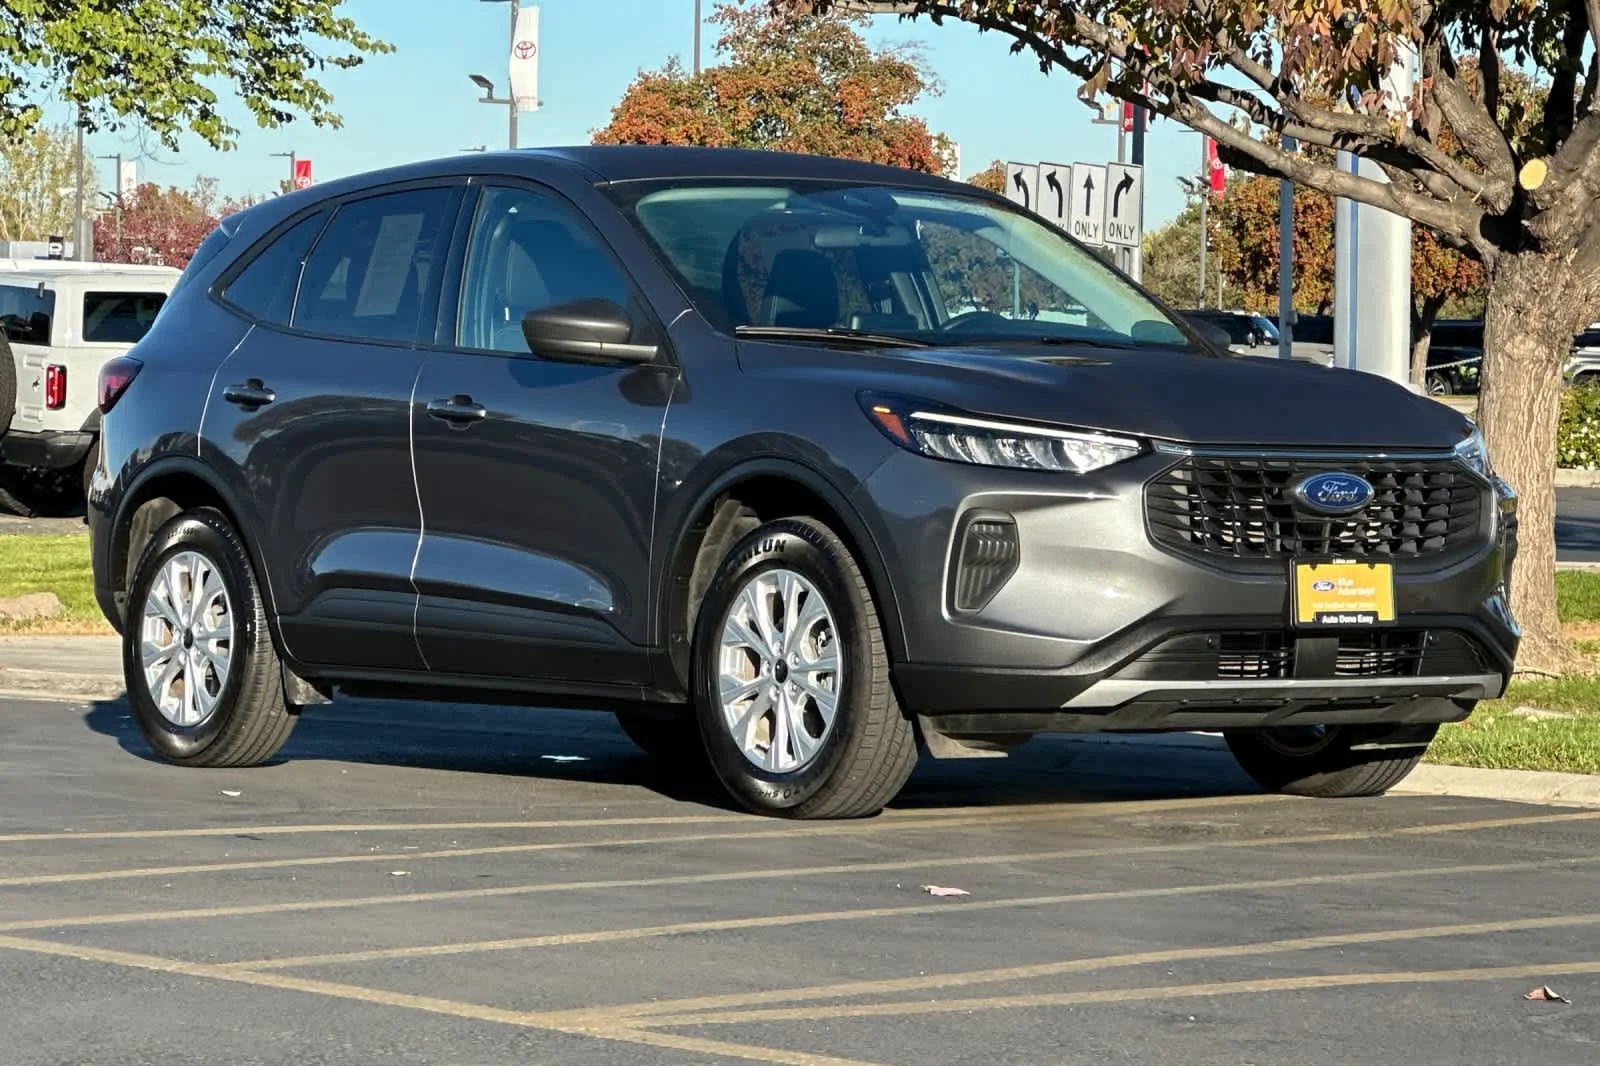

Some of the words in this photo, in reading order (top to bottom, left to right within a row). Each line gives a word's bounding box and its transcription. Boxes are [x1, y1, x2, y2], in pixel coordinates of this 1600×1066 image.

[1075, 220, 1099, 239] ONLY
[1109, 221, 1135, 241] ONLY
[1317, 480, 1359, 502] Ford
